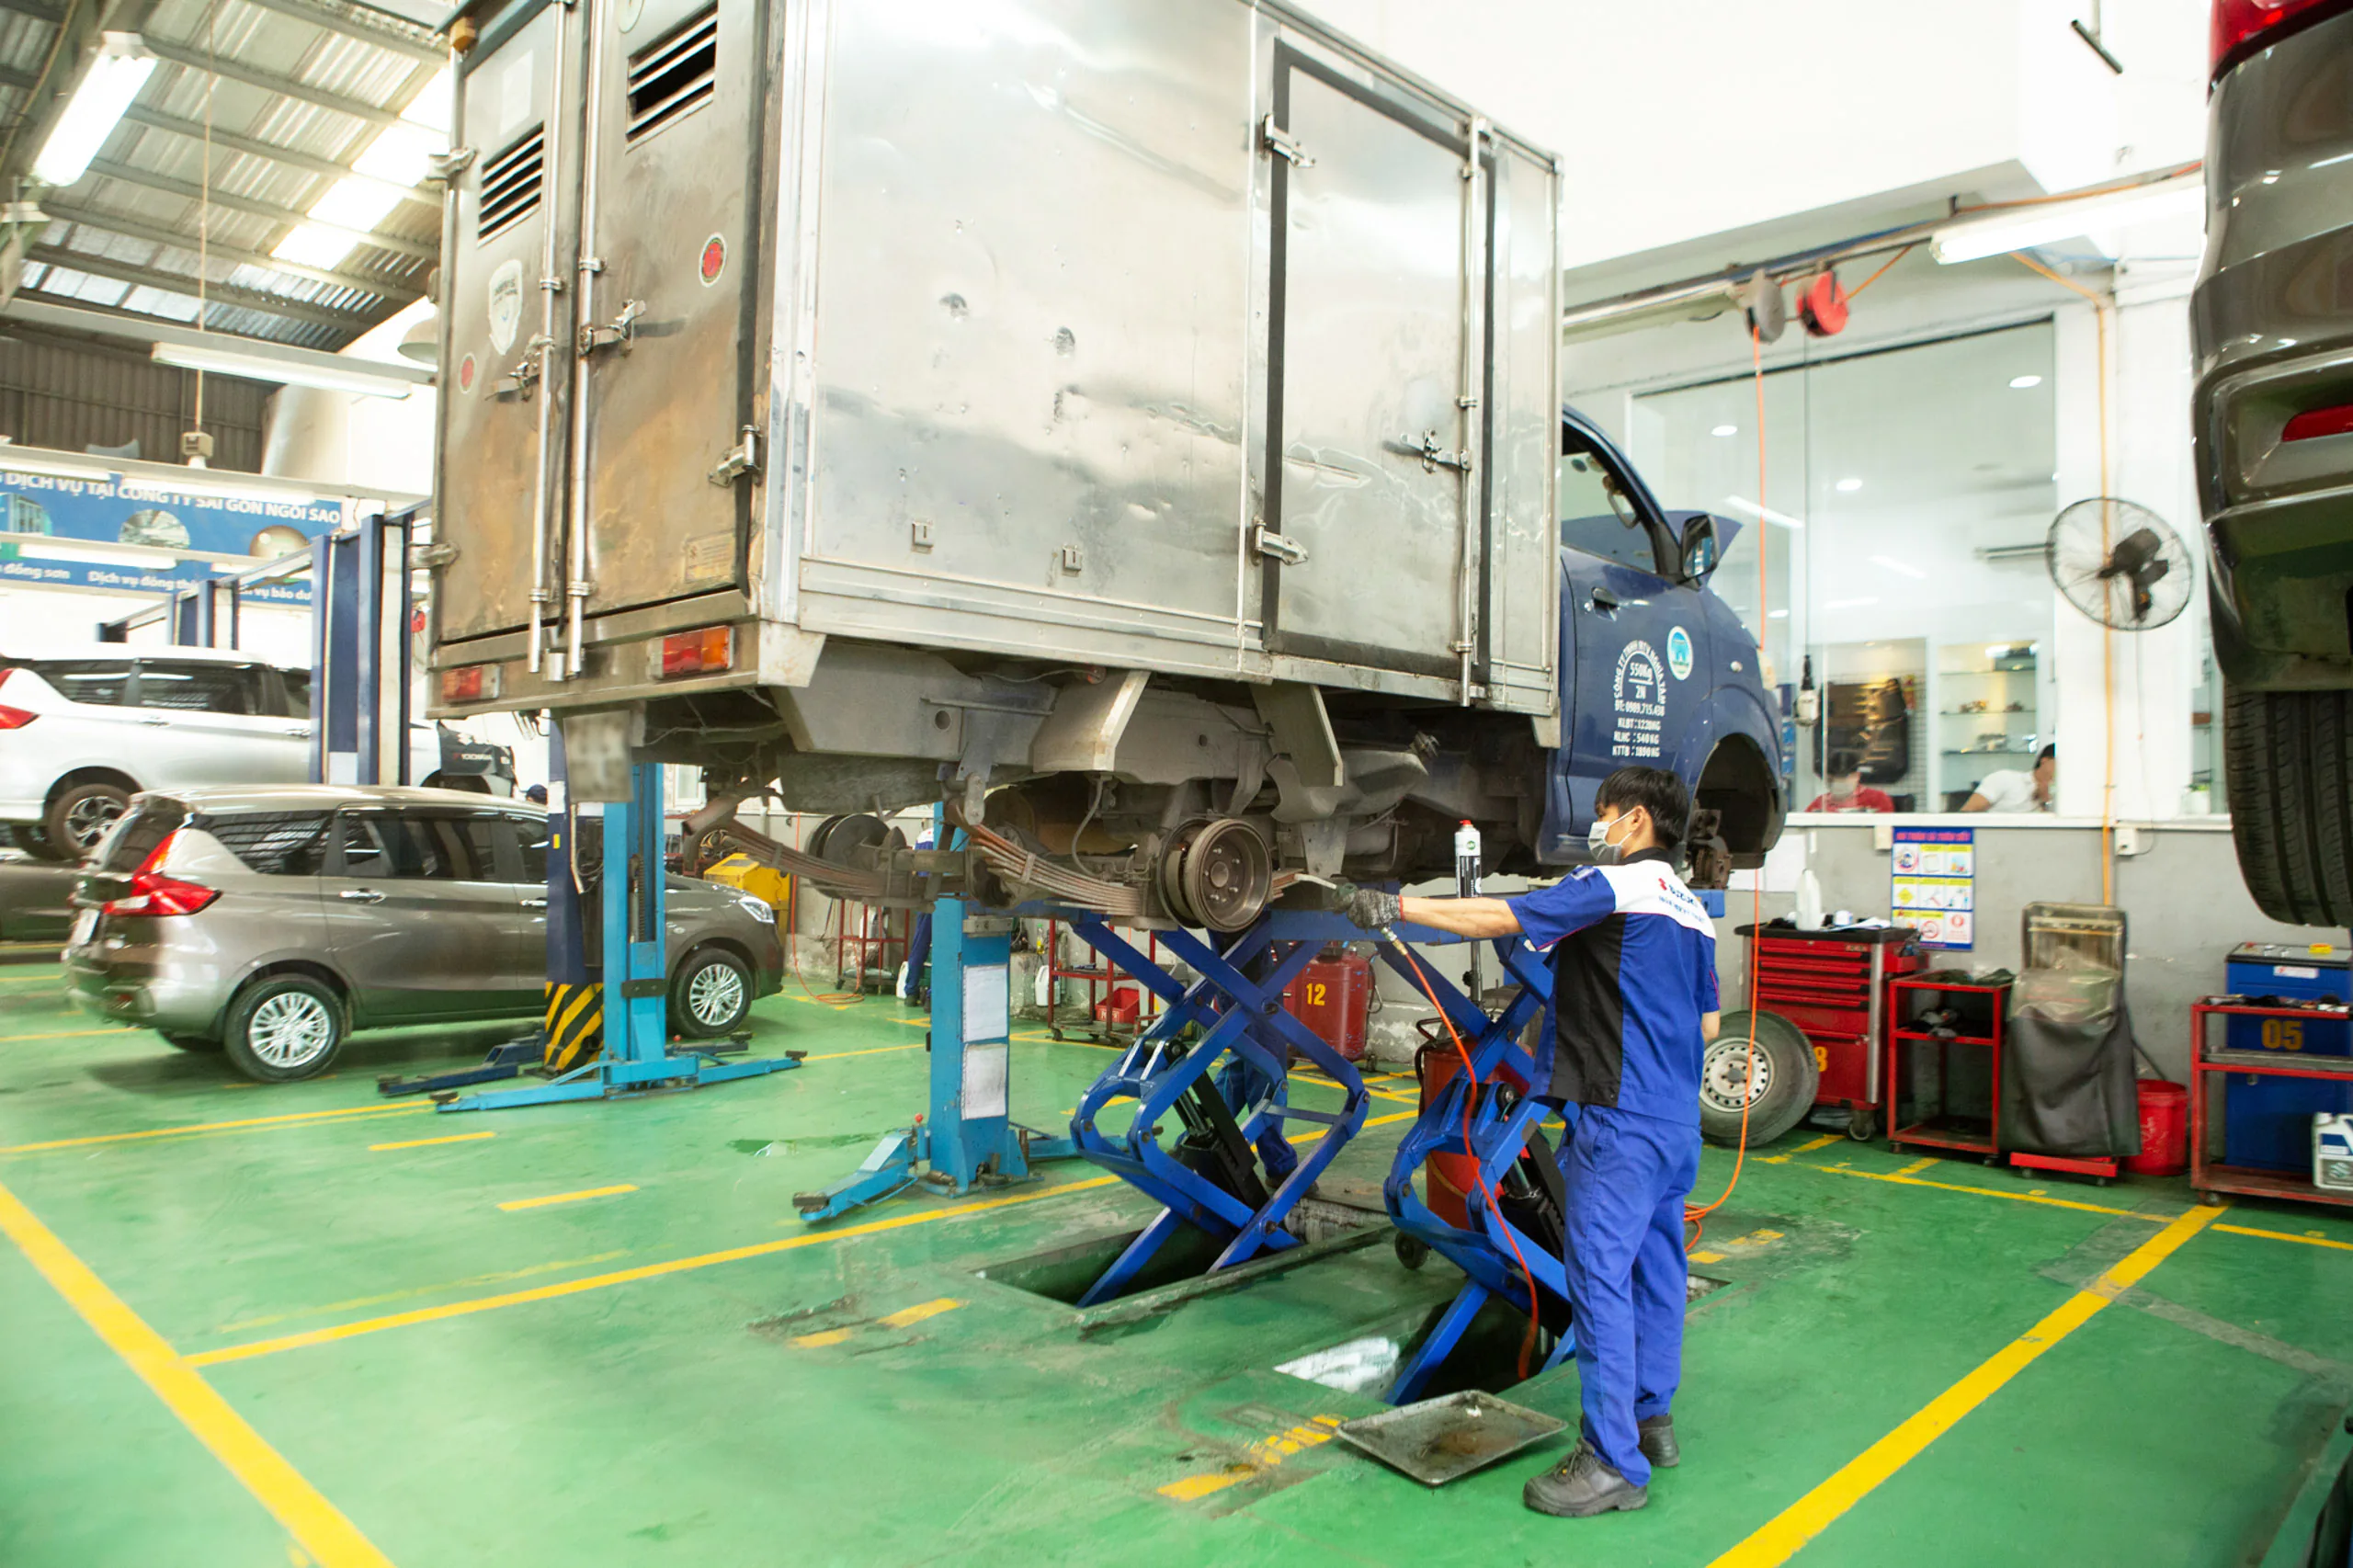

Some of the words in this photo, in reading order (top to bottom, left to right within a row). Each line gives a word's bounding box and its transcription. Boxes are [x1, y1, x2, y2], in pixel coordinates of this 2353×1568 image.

[308, 507, 342, 524] SAO
[1306, 983, 1326, 1006] 12
[2261, 1018, 2303, 1050] 05
